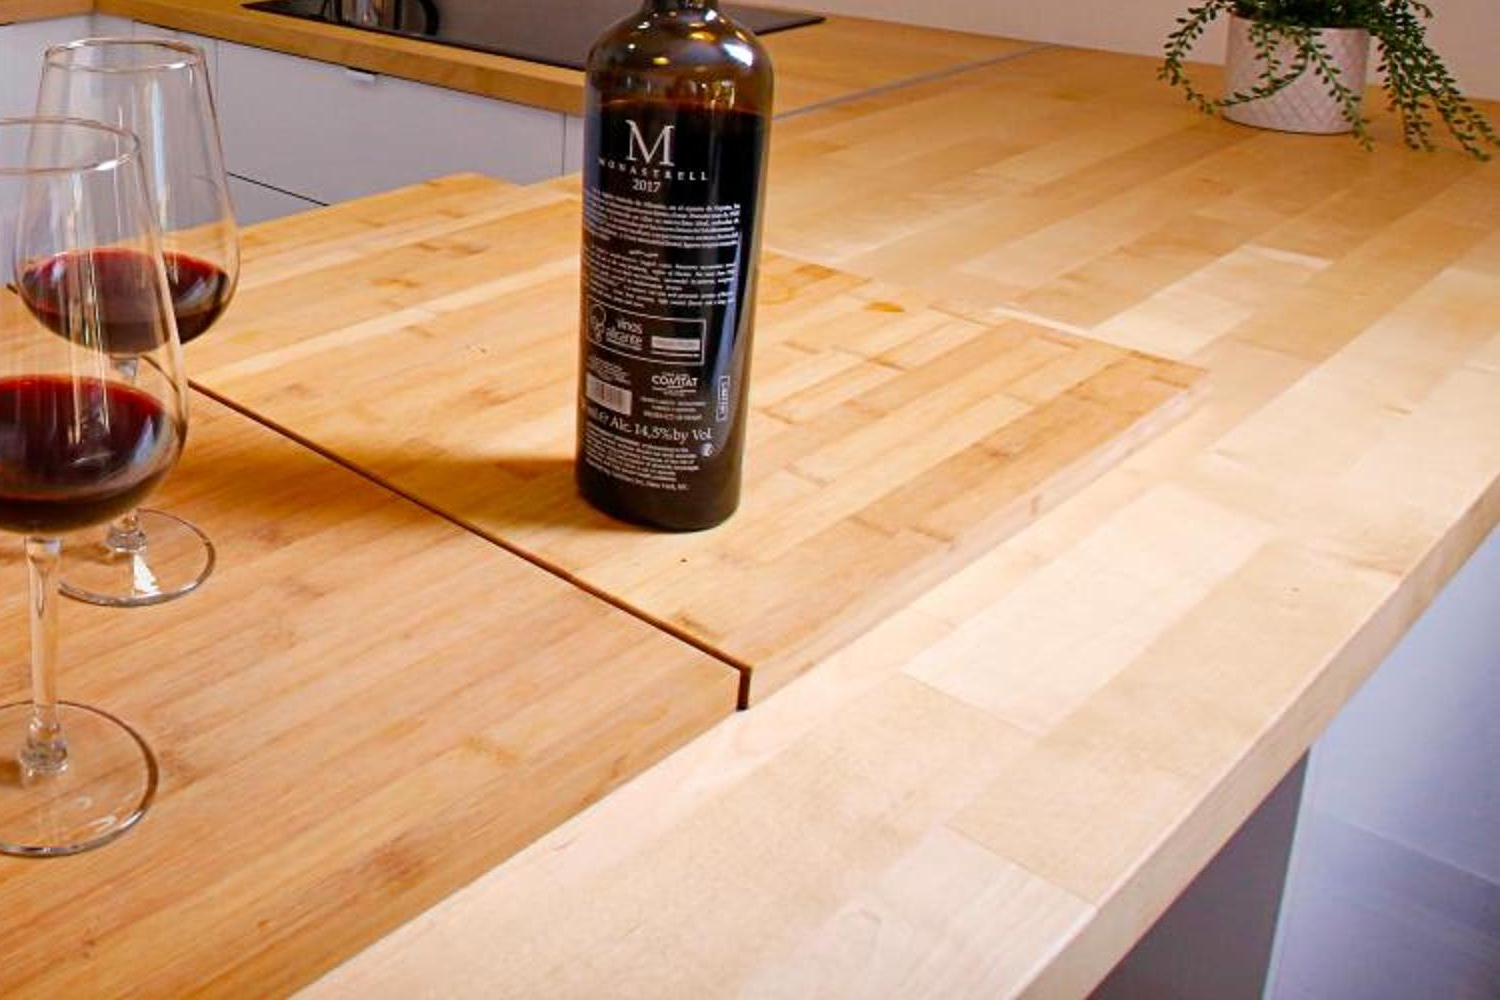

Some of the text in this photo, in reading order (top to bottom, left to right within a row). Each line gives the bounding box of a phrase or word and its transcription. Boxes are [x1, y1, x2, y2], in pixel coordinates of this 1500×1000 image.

[625, 118, 675, 167] M
[597, 155, 708, 182] MONASTRELL
[631, 178, 662, 194] 2017
